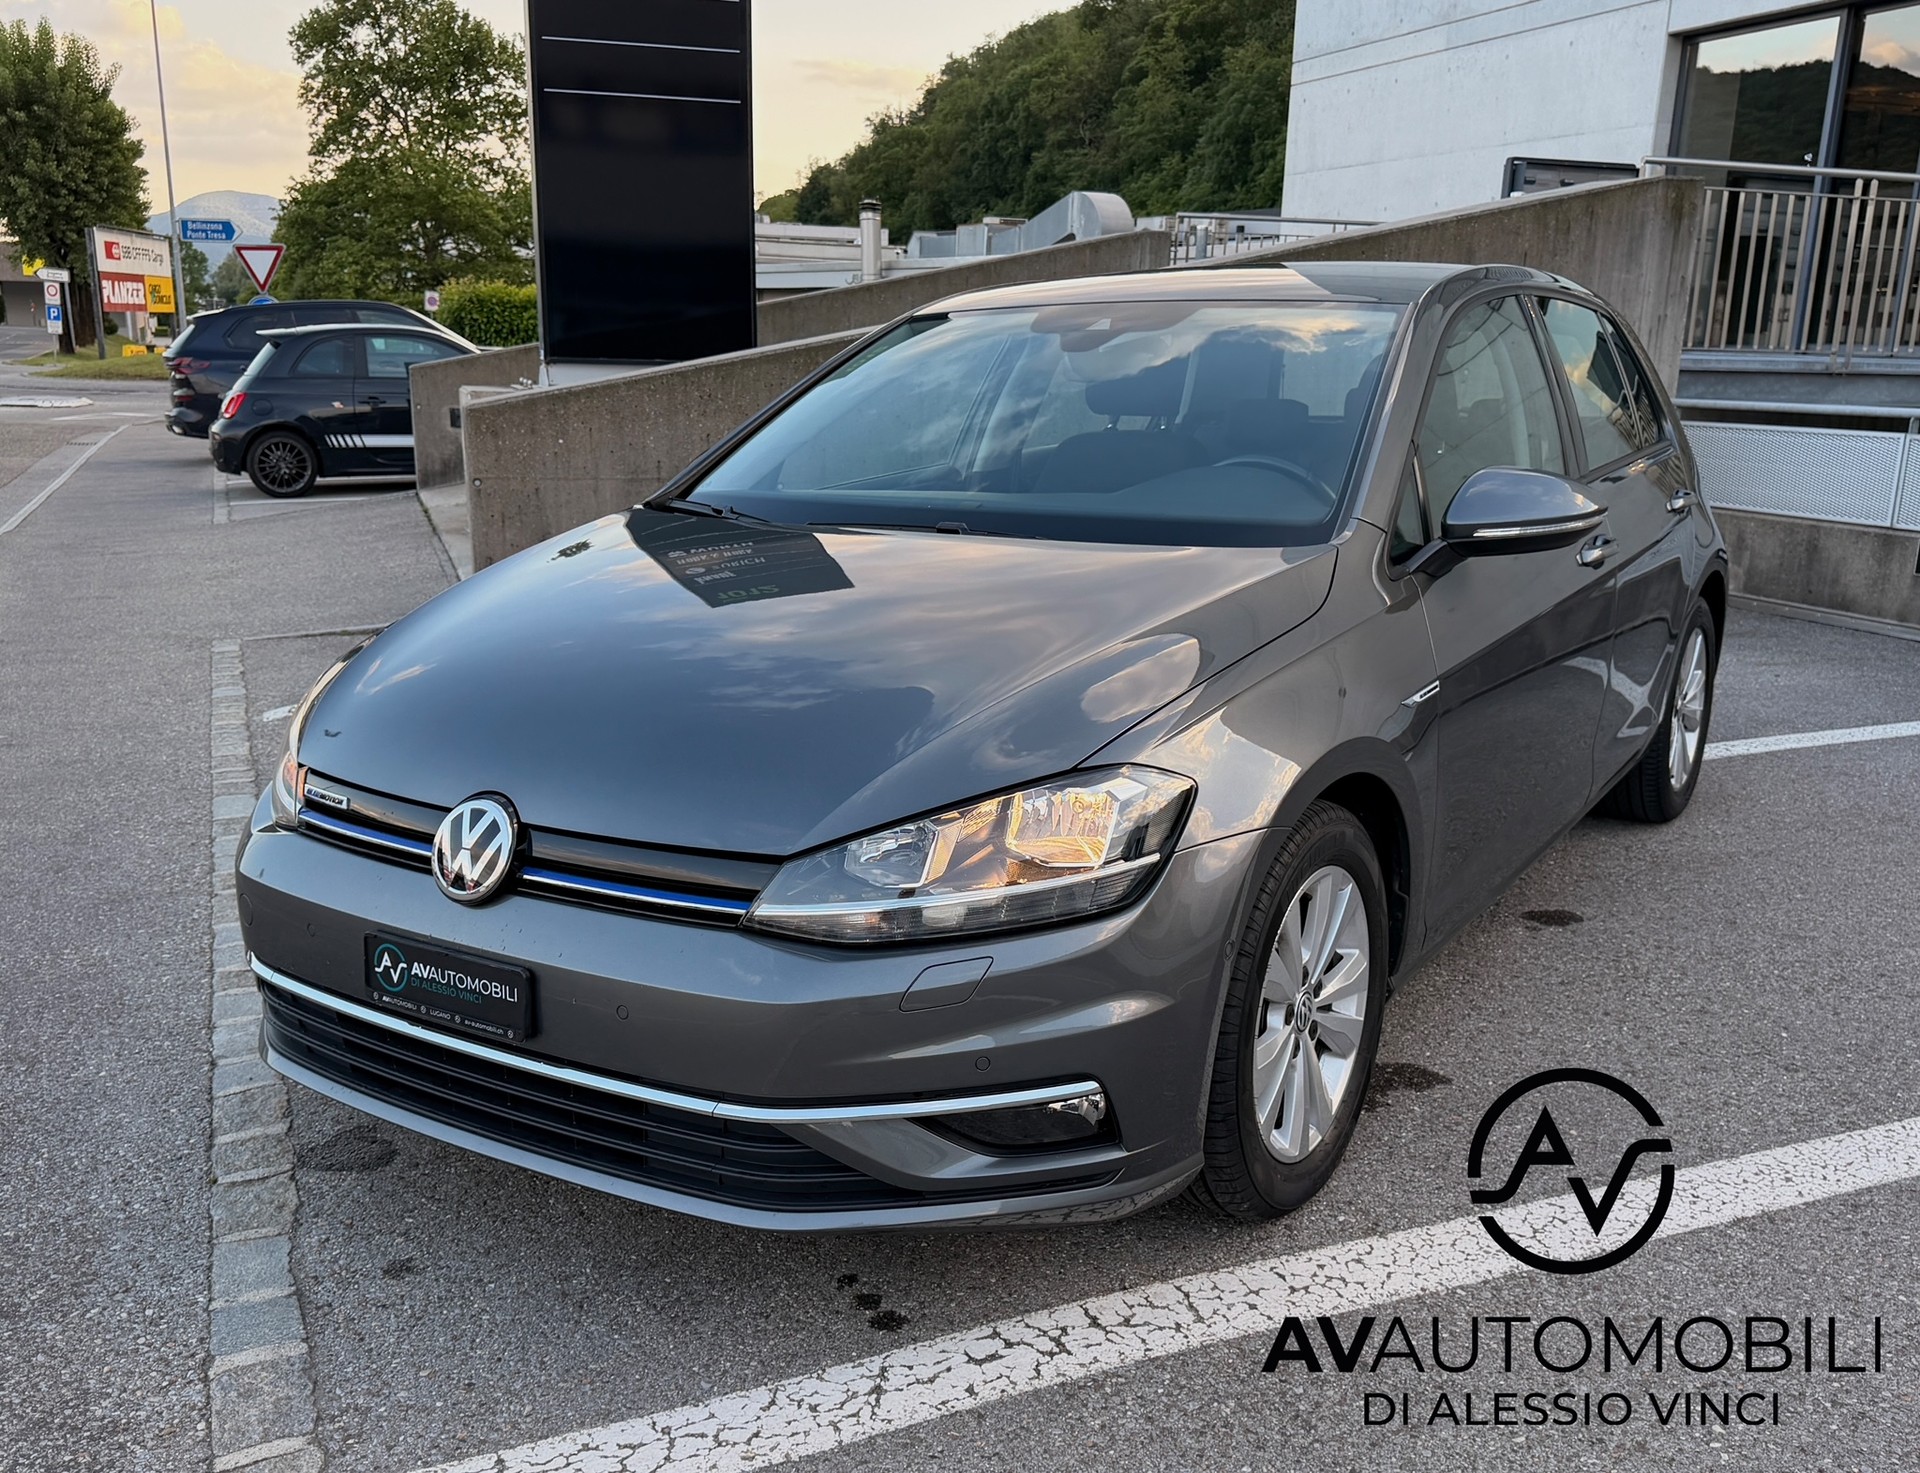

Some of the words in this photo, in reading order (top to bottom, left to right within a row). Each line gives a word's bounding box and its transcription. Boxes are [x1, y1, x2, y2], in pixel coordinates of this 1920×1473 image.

[187, 221, 223, 230] Bellinzona
[187, 230, 207, 239] Ponte
[207, 230, 226, 239] Tresa
[101, 279, 146, 305] PLANZER
[50, 307, 58, 320] P
[411, 961, 518, 1003] AVAUTOMOBILI
[411, 977, 420, 988] DI
[421, 978, 457, 997] ALESSIO
[458, 990, 482, 1004] VINCI
[429, 1008, 451, 1020] LUGANO
